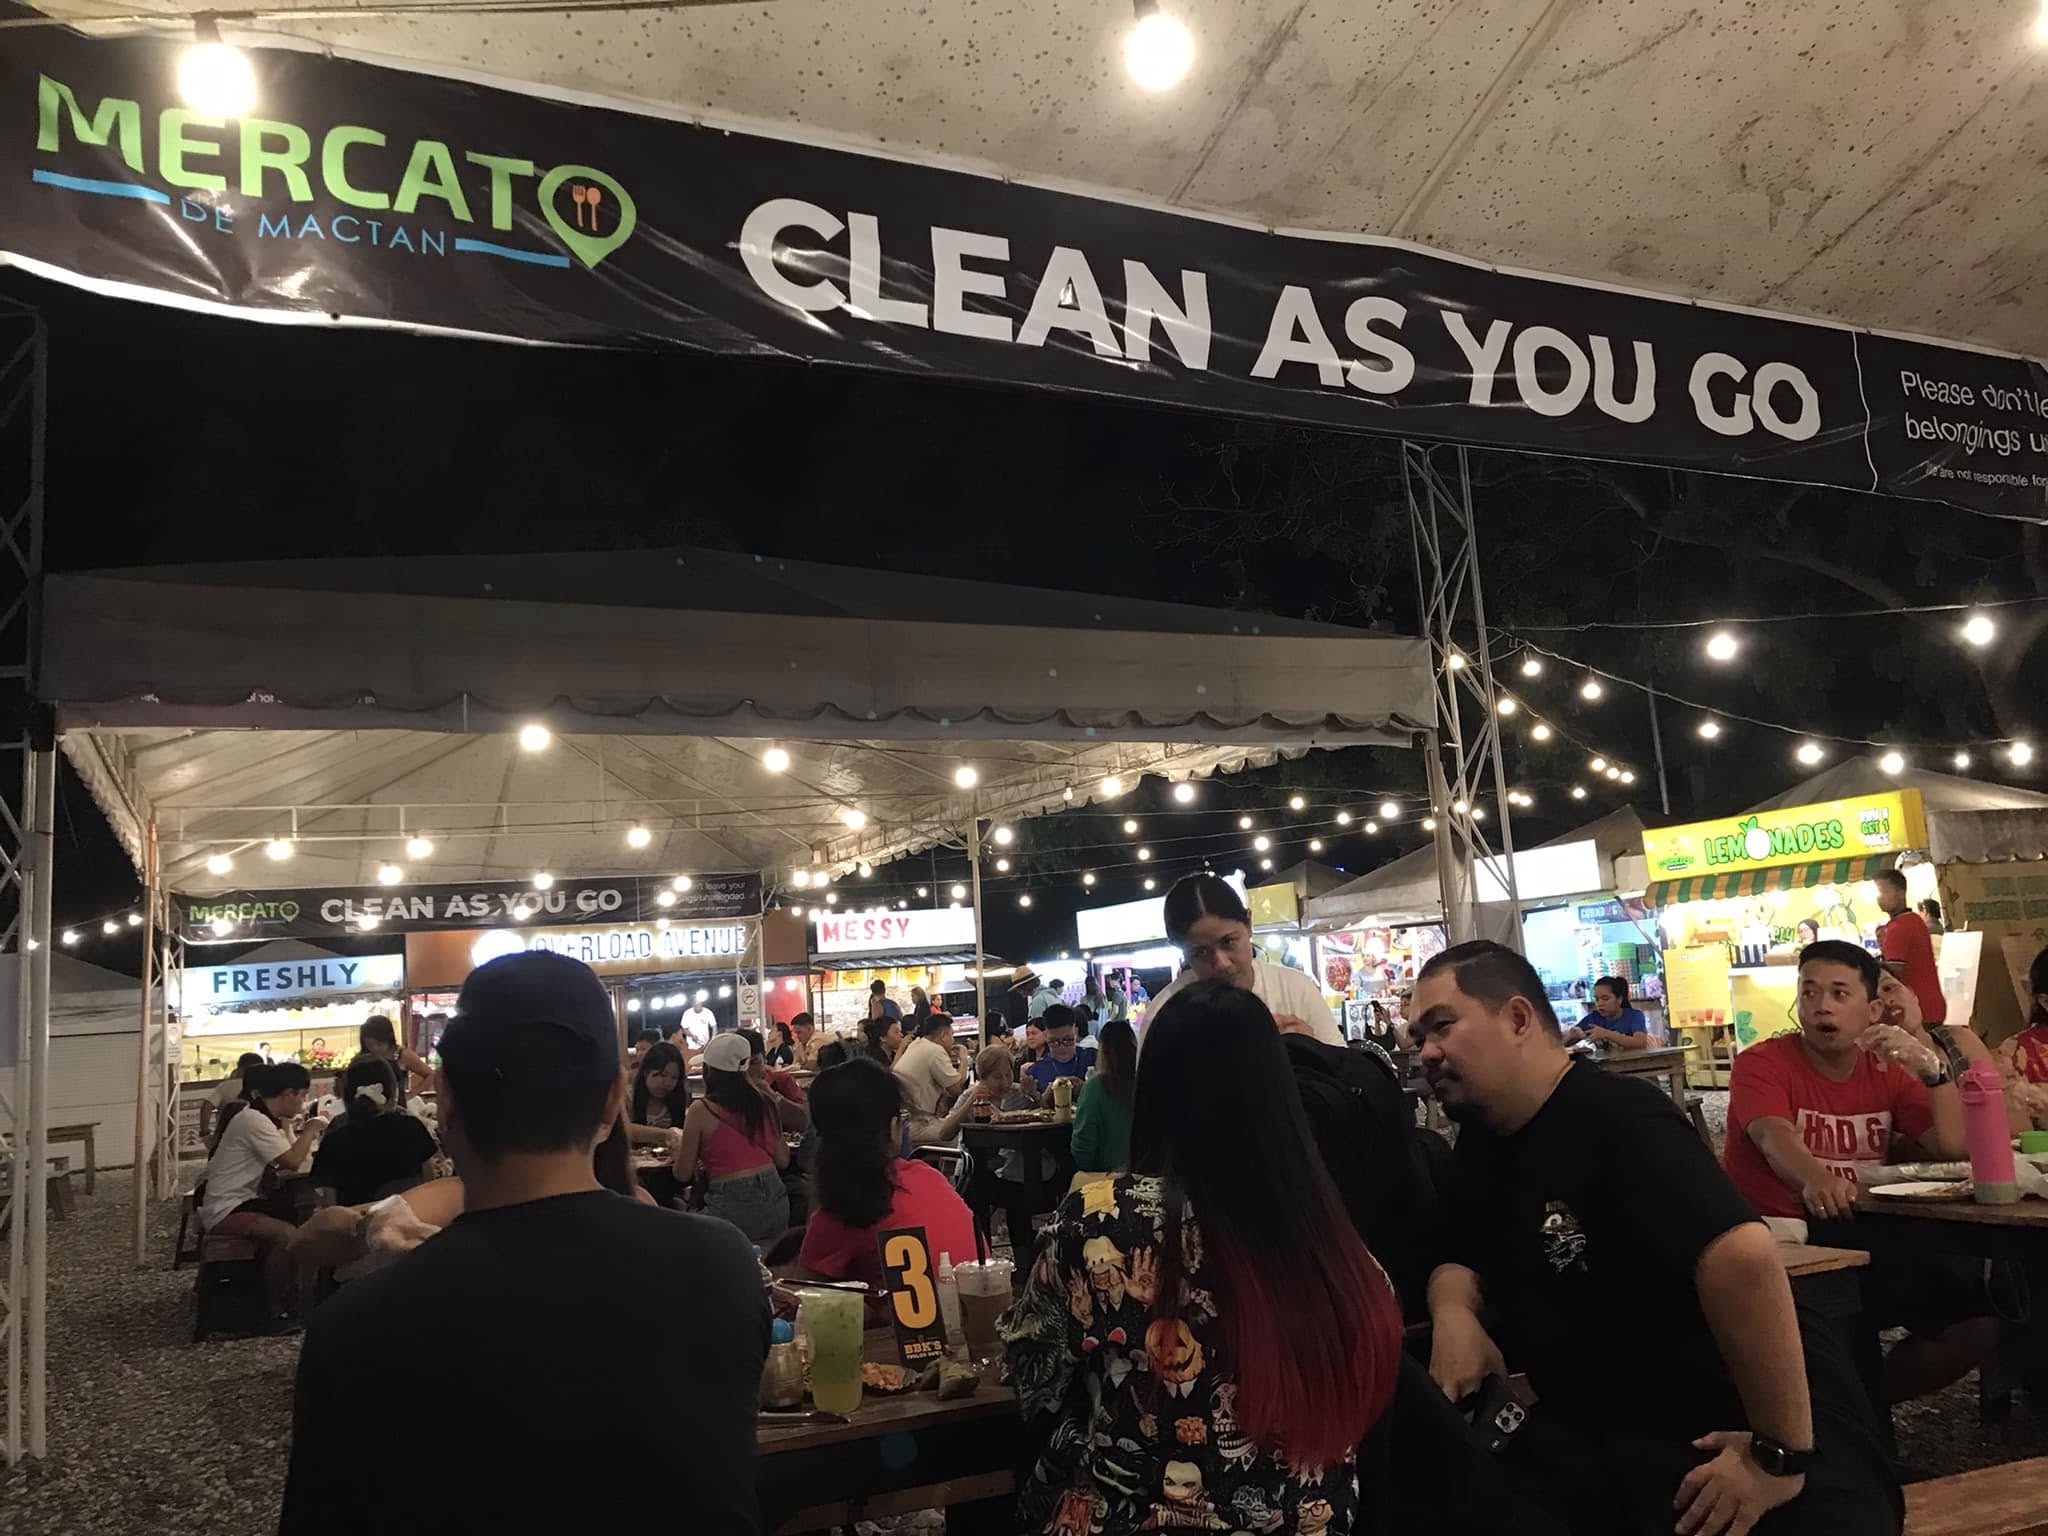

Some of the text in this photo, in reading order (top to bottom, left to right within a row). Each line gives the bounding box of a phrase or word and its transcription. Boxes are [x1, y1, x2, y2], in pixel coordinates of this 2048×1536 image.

[36, 72, 636, 270] MERCATO
[181, 199, 446, 257] DE MACTAN
[740, 198, 1821, 441] CLEAN AS YOU GO
[1900, 371, 1975, 406] Please
[1982, 384, 2034, 412] don't
[1905, 412, 2021, 456] belongings
[1940, 468, 1954, 479] are
[1957, 469, 1972, 481] not
[2032, 474, 2048, 487] for
[1704, 819, 1845, 866] LEMONADES
[189, 901, 300, 922] MERCATO
[320, 889, 623, 923] CLEAN AS YOU GO
[663, 926, 746, 956] AVENUE
[822, 917, 910, 943] MESSY
[213, 962, 359, 993] FRESHLY
[885, 1235, 937, 1328] 3
